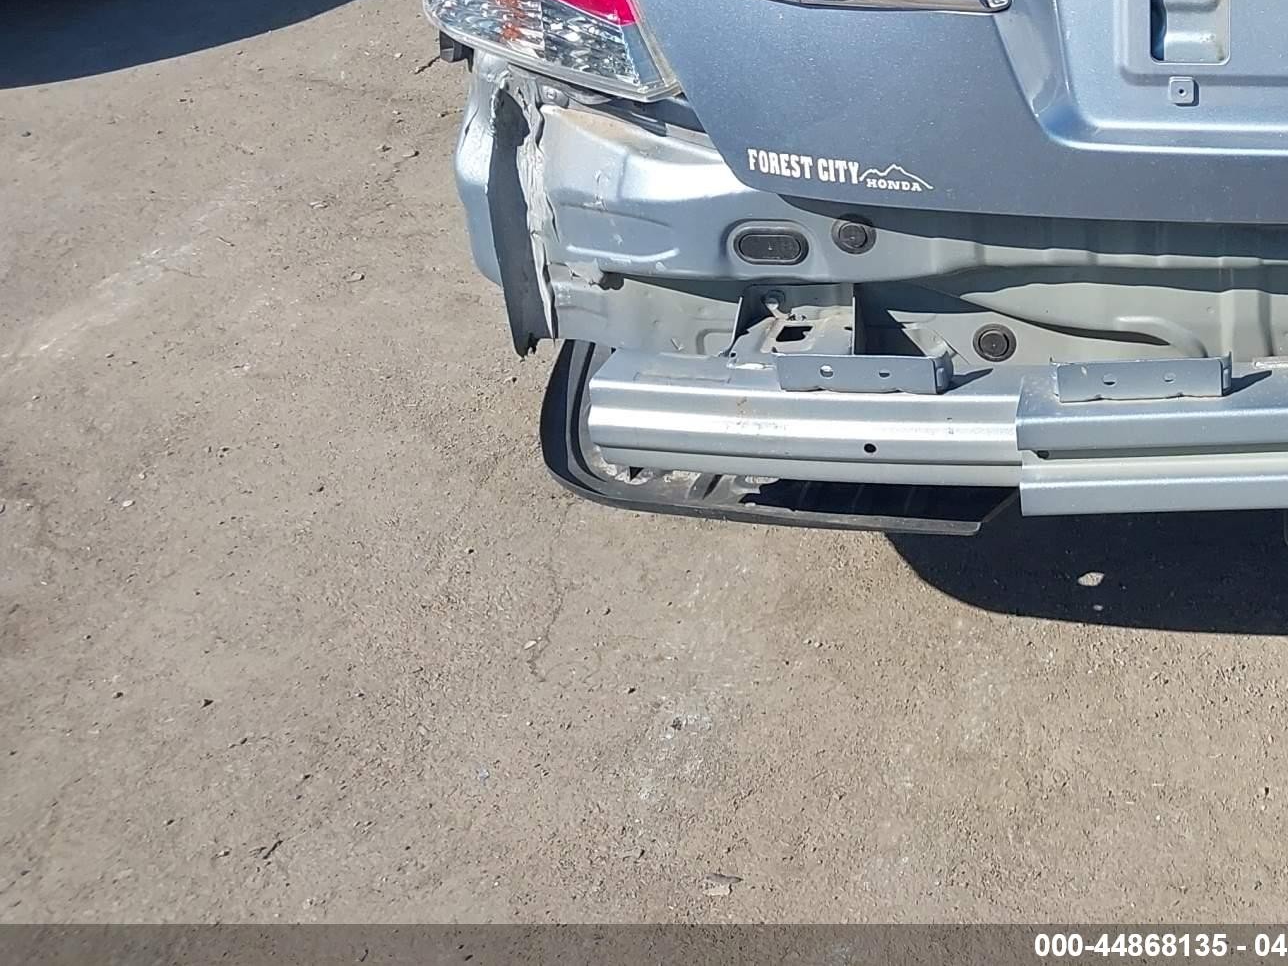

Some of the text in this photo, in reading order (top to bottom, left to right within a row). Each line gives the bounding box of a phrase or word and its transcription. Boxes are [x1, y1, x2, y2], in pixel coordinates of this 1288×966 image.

[747, 148, 860, 185] FOREST CITY
[866, 178, 922, 192] HONDA
